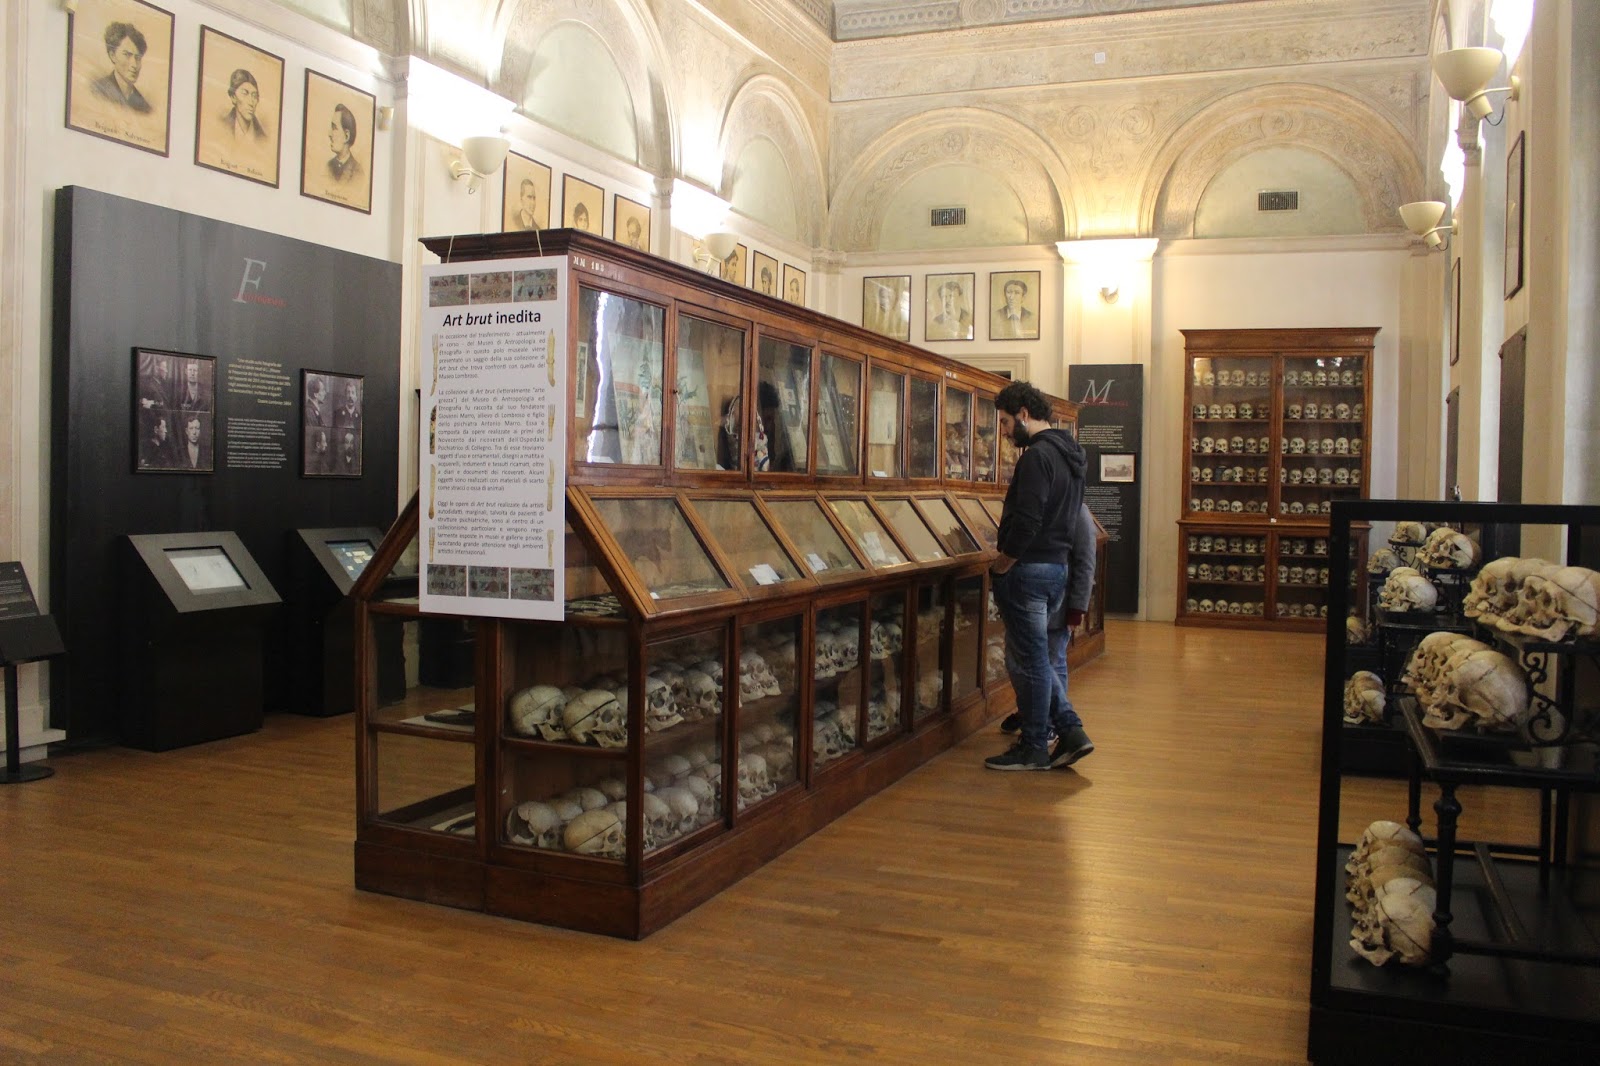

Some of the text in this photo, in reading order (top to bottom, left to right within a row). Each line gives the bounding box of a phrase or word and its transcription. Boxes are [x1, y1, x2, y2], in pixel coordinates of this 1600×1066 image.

[442, 308, 541, 327] Art brut inedita
[1080, 379, 1115, 404] M
